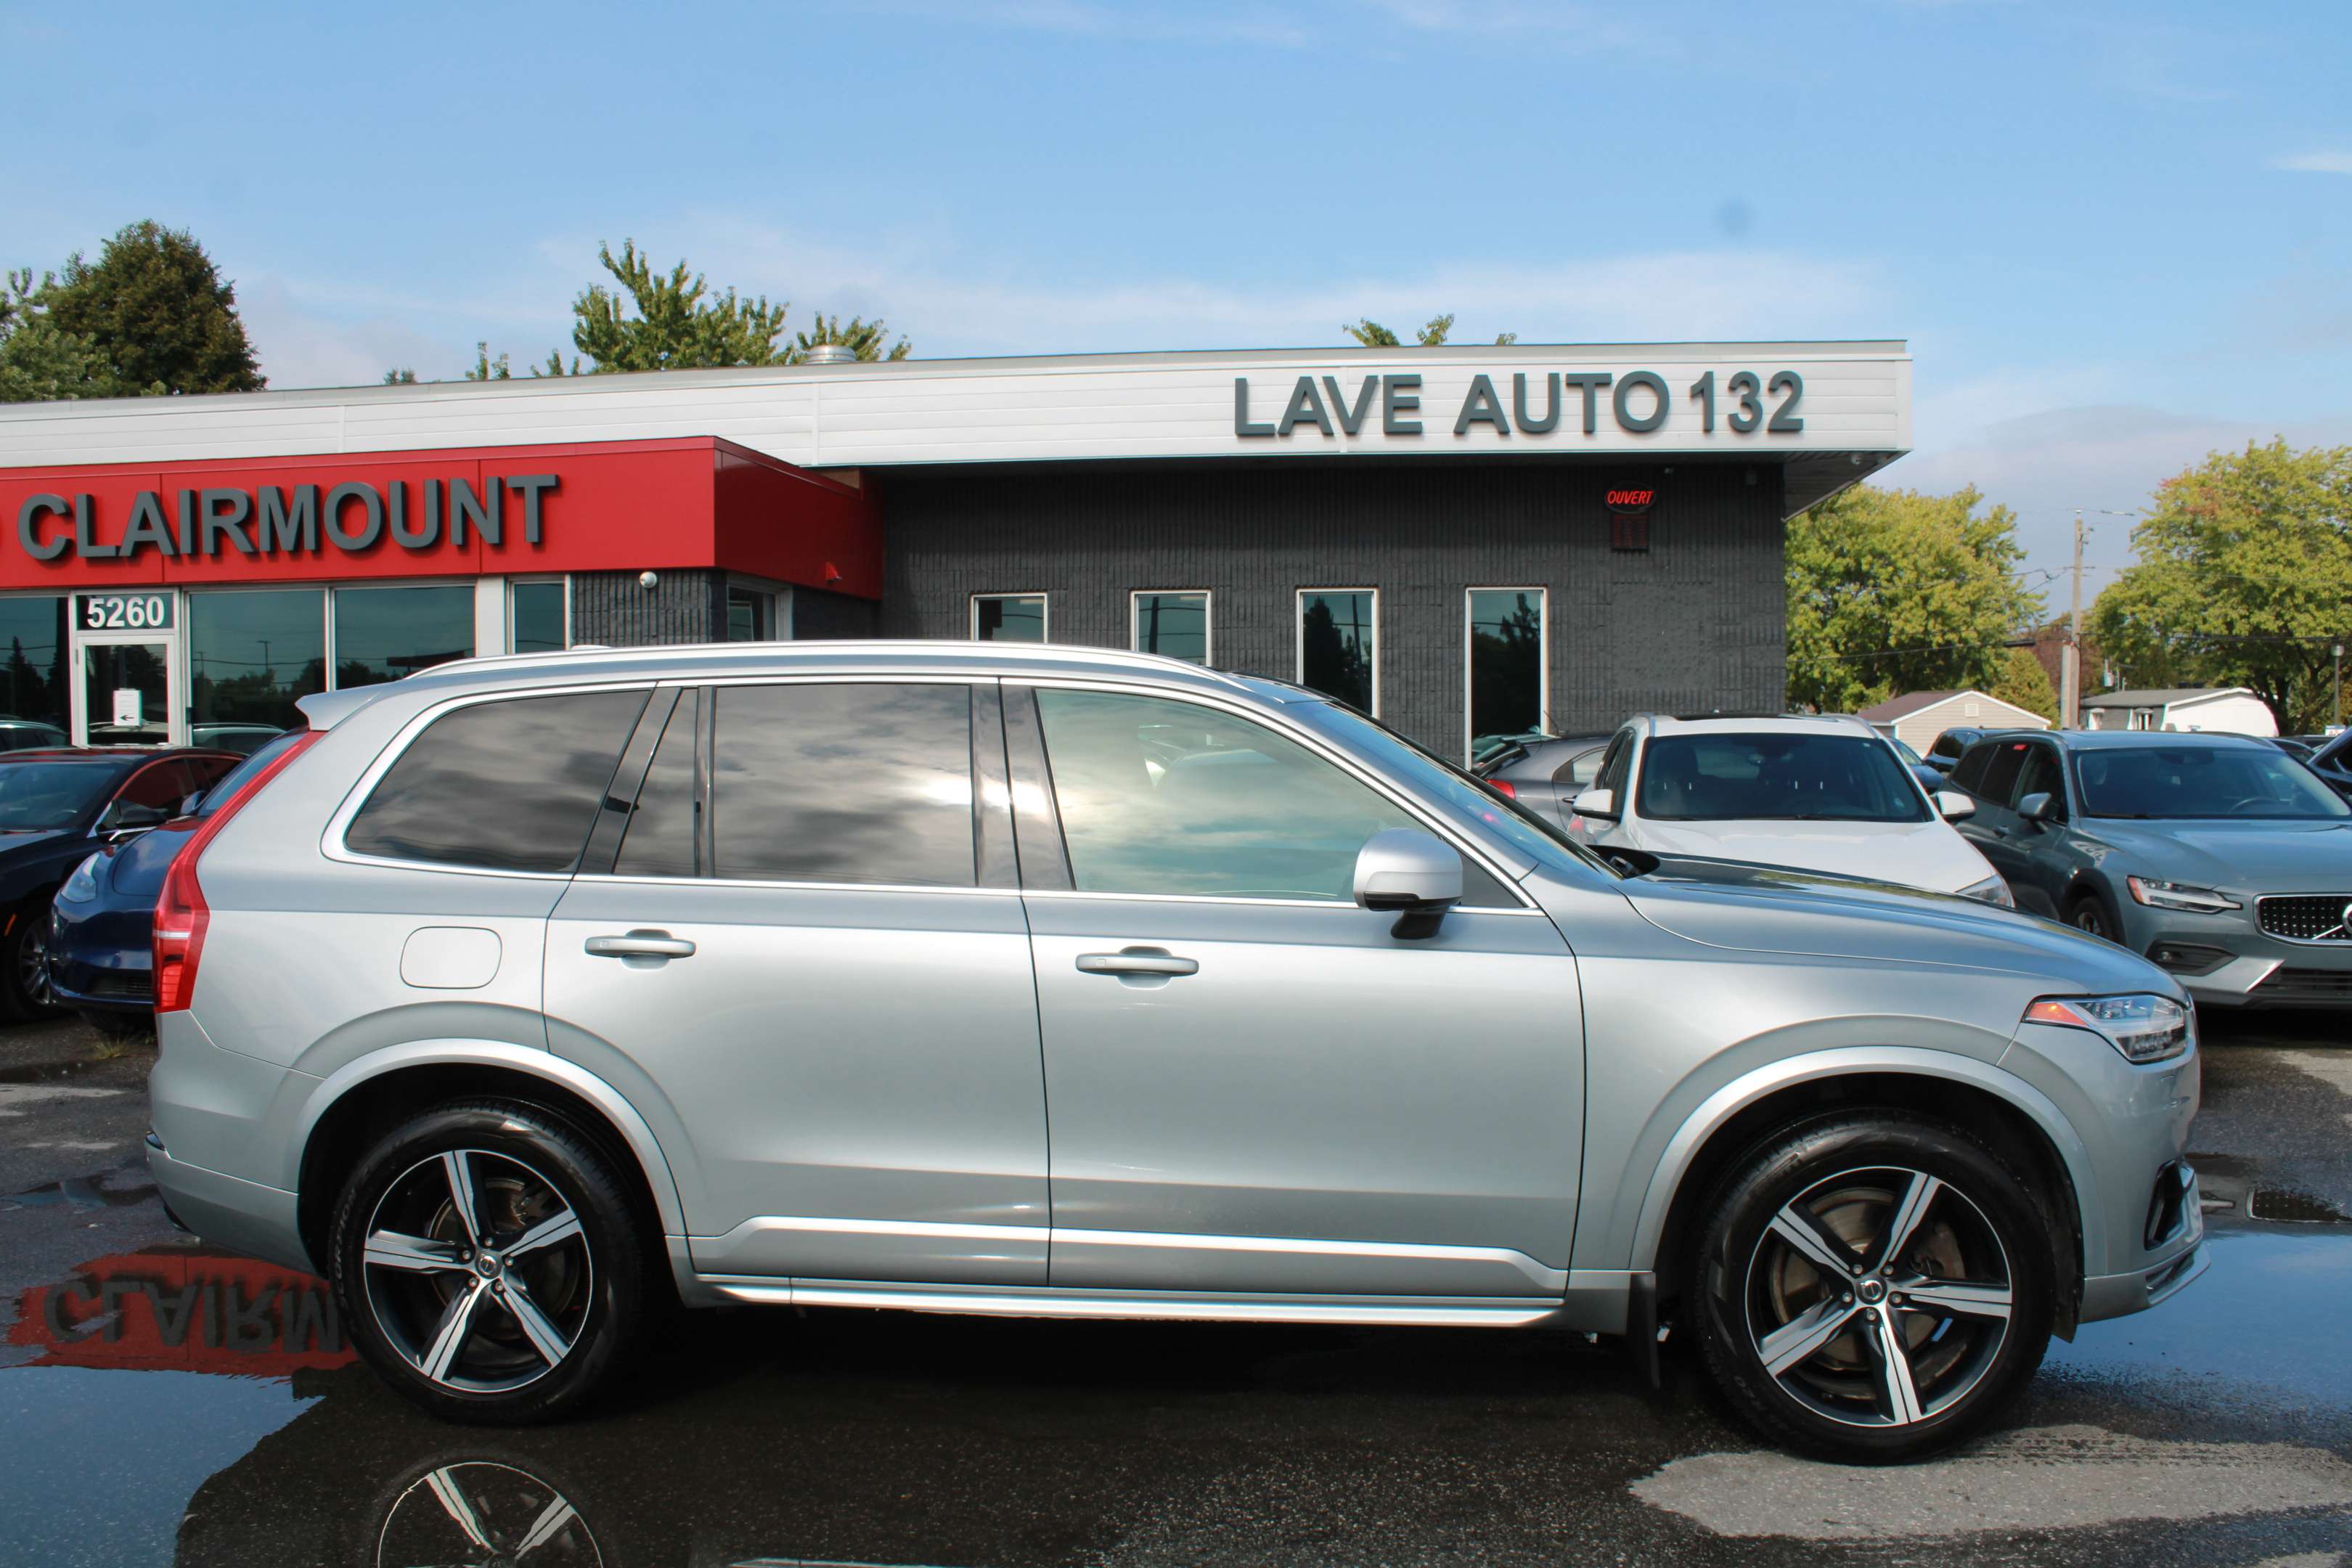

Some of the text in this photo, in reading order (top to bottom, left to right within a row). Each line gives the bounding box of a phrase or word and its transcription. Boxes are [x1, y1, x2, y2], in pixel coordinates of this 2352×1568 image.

[1234, 370, 1804, 436] LAVE AUTO 132
[17, 473, 560, 560] CLAIRMOUNT
[1606, 490, 1653, 505] OUVERT
[86, 596, 165, 628] 5260
